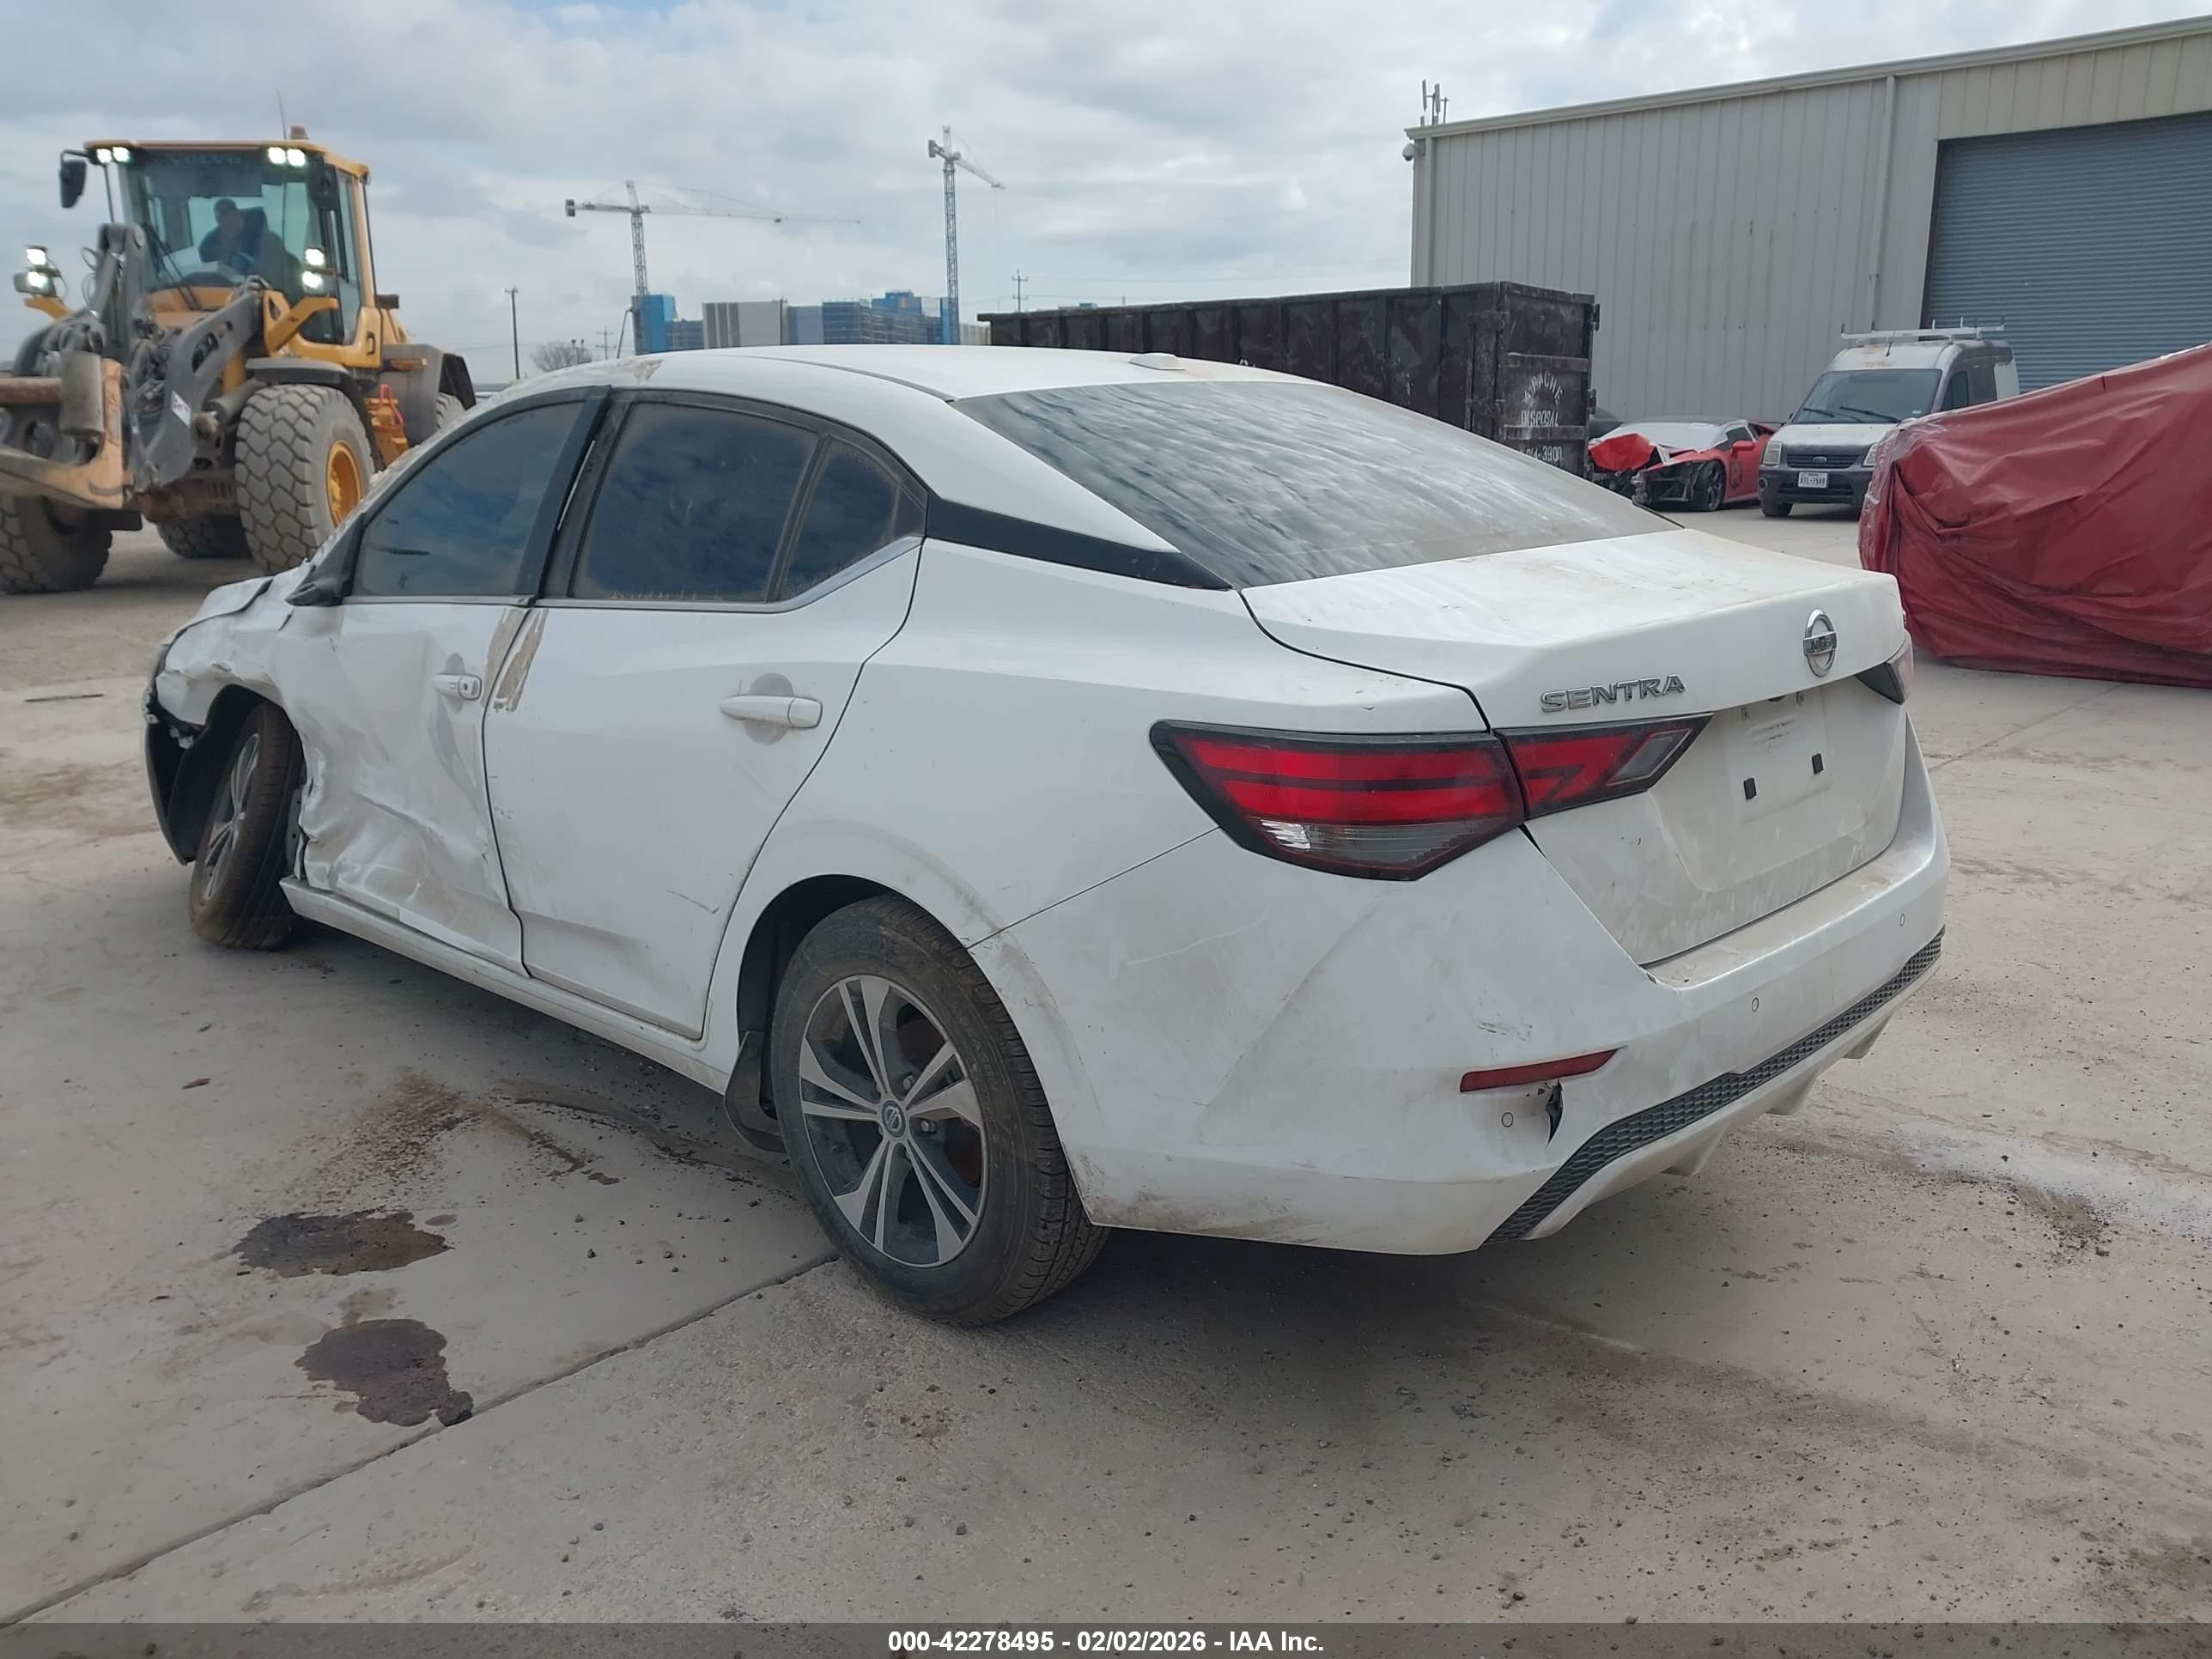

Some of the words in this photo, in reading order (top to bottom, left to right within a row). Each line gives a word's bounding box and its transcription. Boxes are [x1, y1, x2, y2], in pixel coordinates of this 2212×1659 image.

[1523, 371, 1563, 407] APACHE
[1521, 410, 1560, 427] DISPOSAL
[1540, 673, 1686, 713] SENTRA
